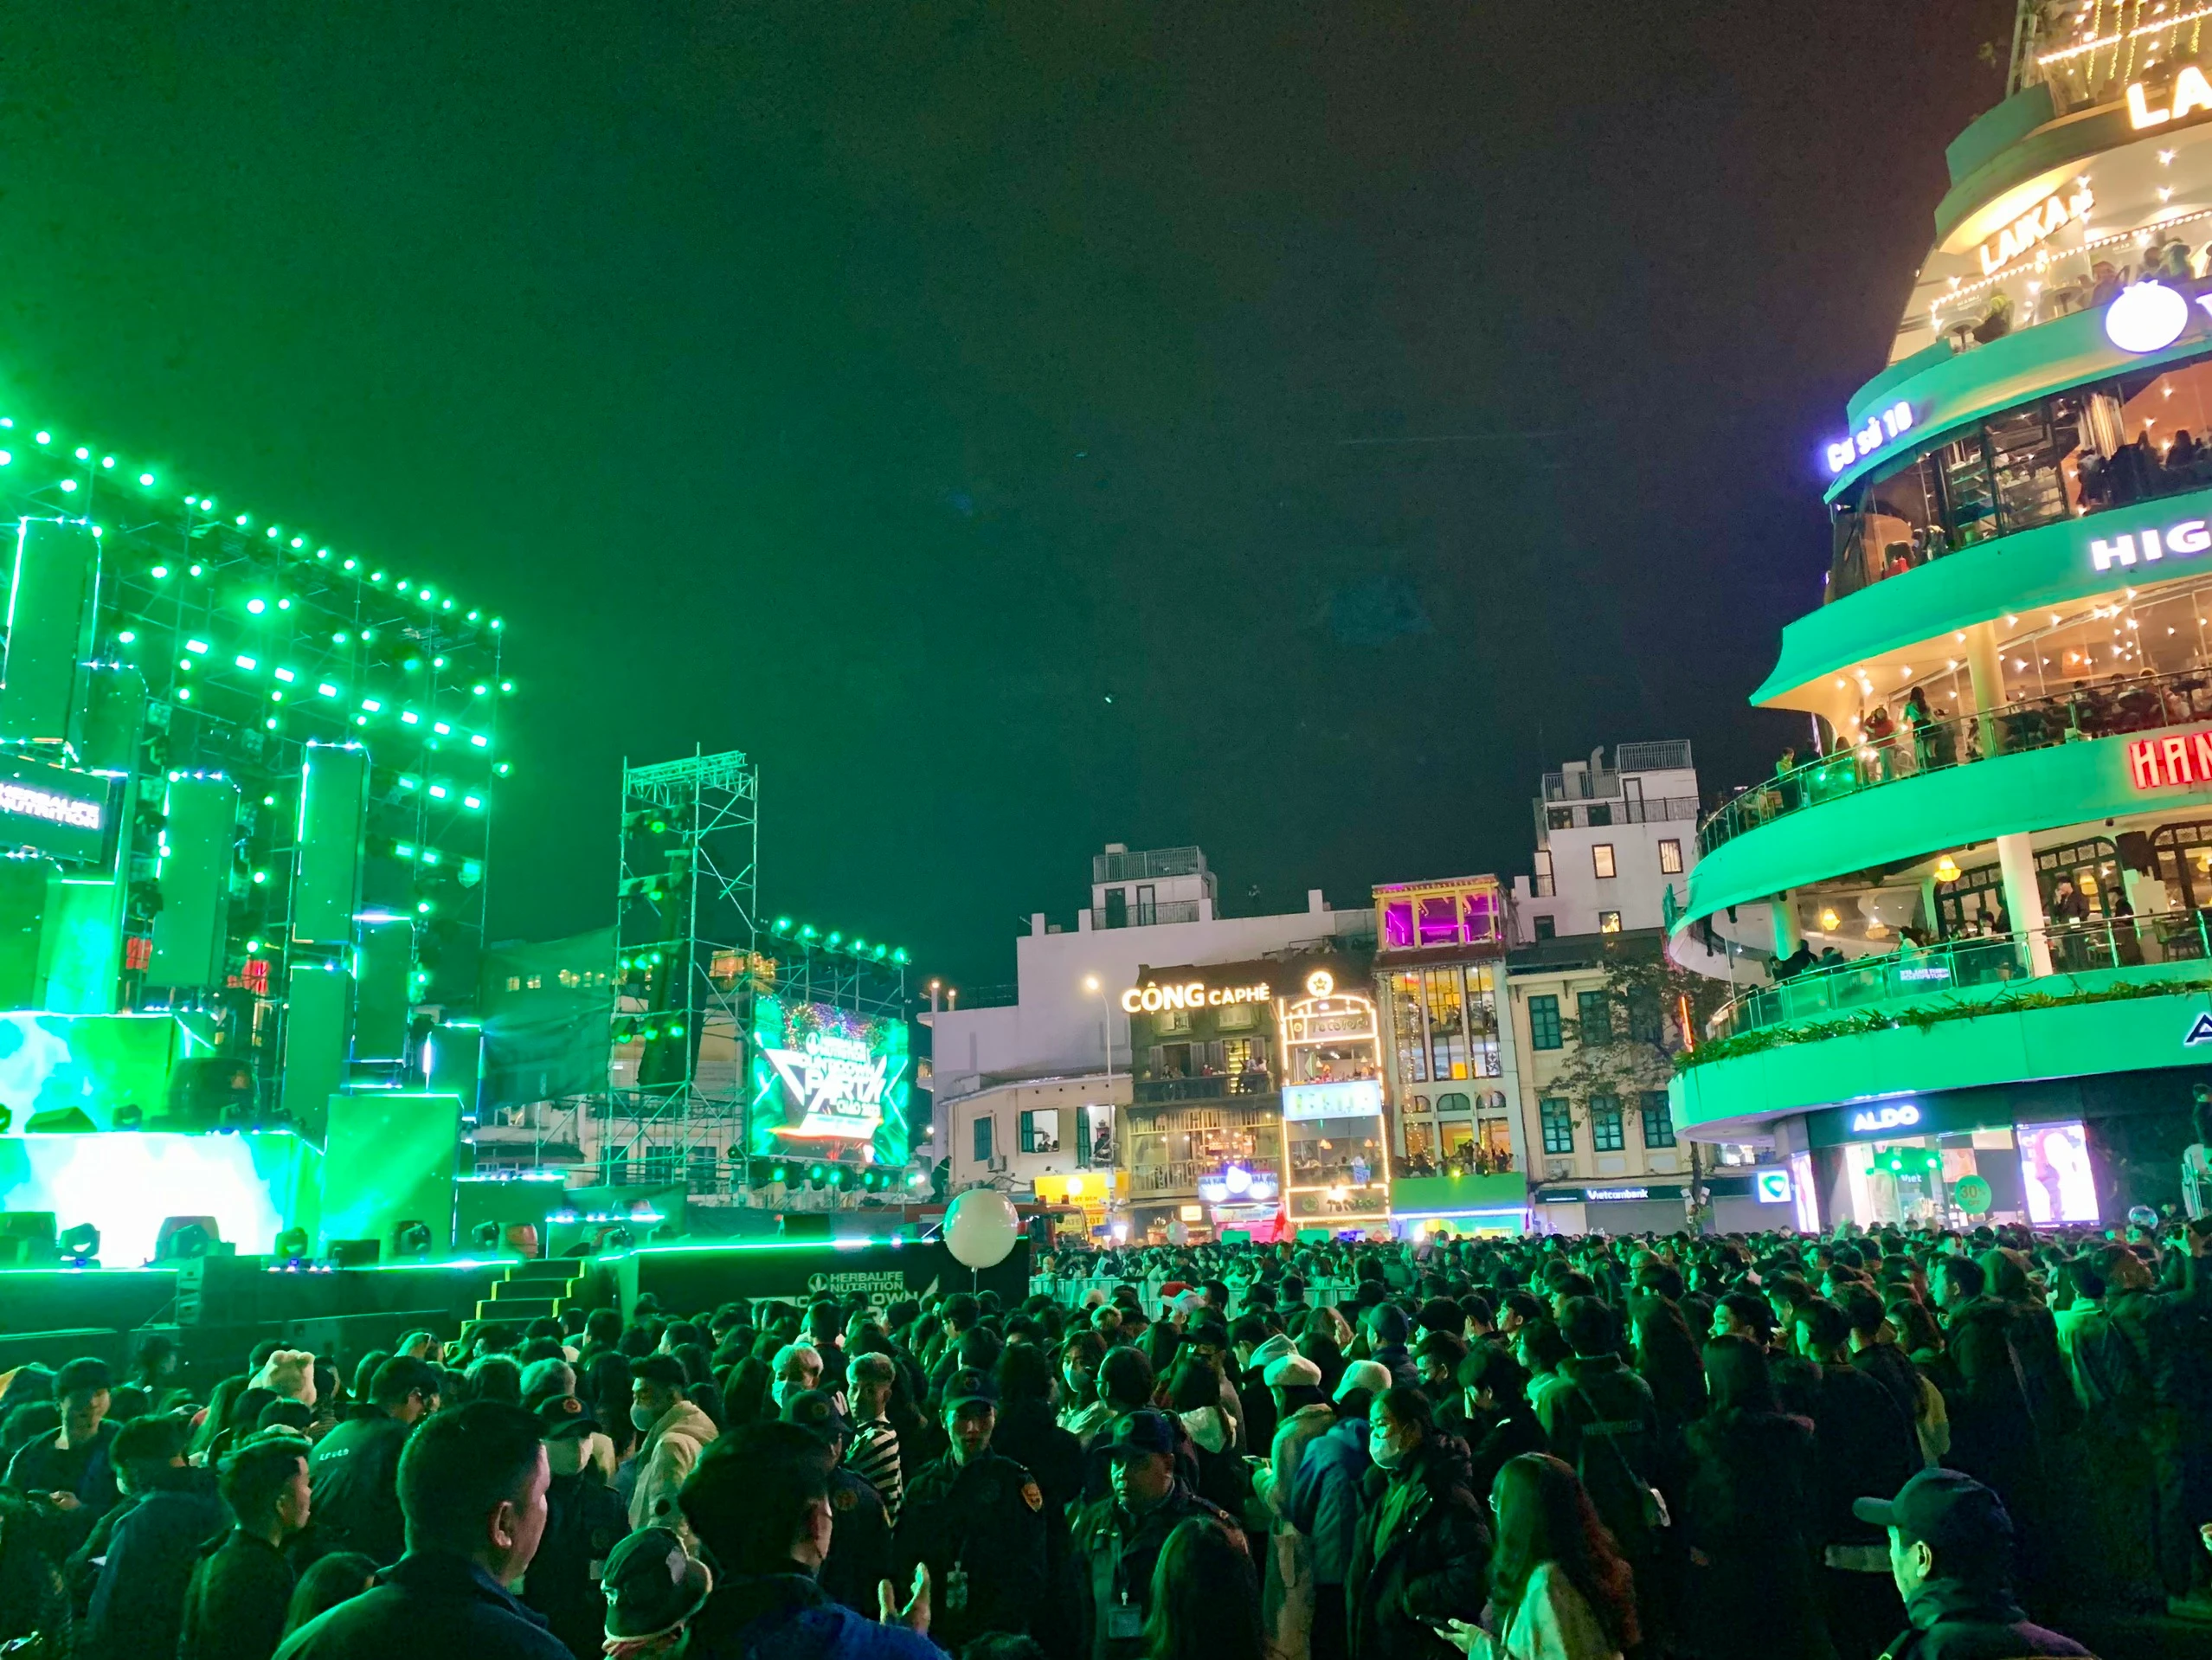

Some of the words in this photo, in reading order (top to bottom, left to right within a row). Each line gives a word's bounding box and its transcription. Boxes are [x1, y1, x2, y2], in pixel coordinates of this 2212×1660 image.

[1883, 401, 1913, 438] 10
[2091, 520, 2212, 570] HIG
[1854, 1105, 1919, 1131] ALDO
[1586, 1188, 1649, 1200] Vietcombank
[830, 1271, 903, 1283] HERBALIFE
[830, 1281, 903, 1293] NUTRITION
